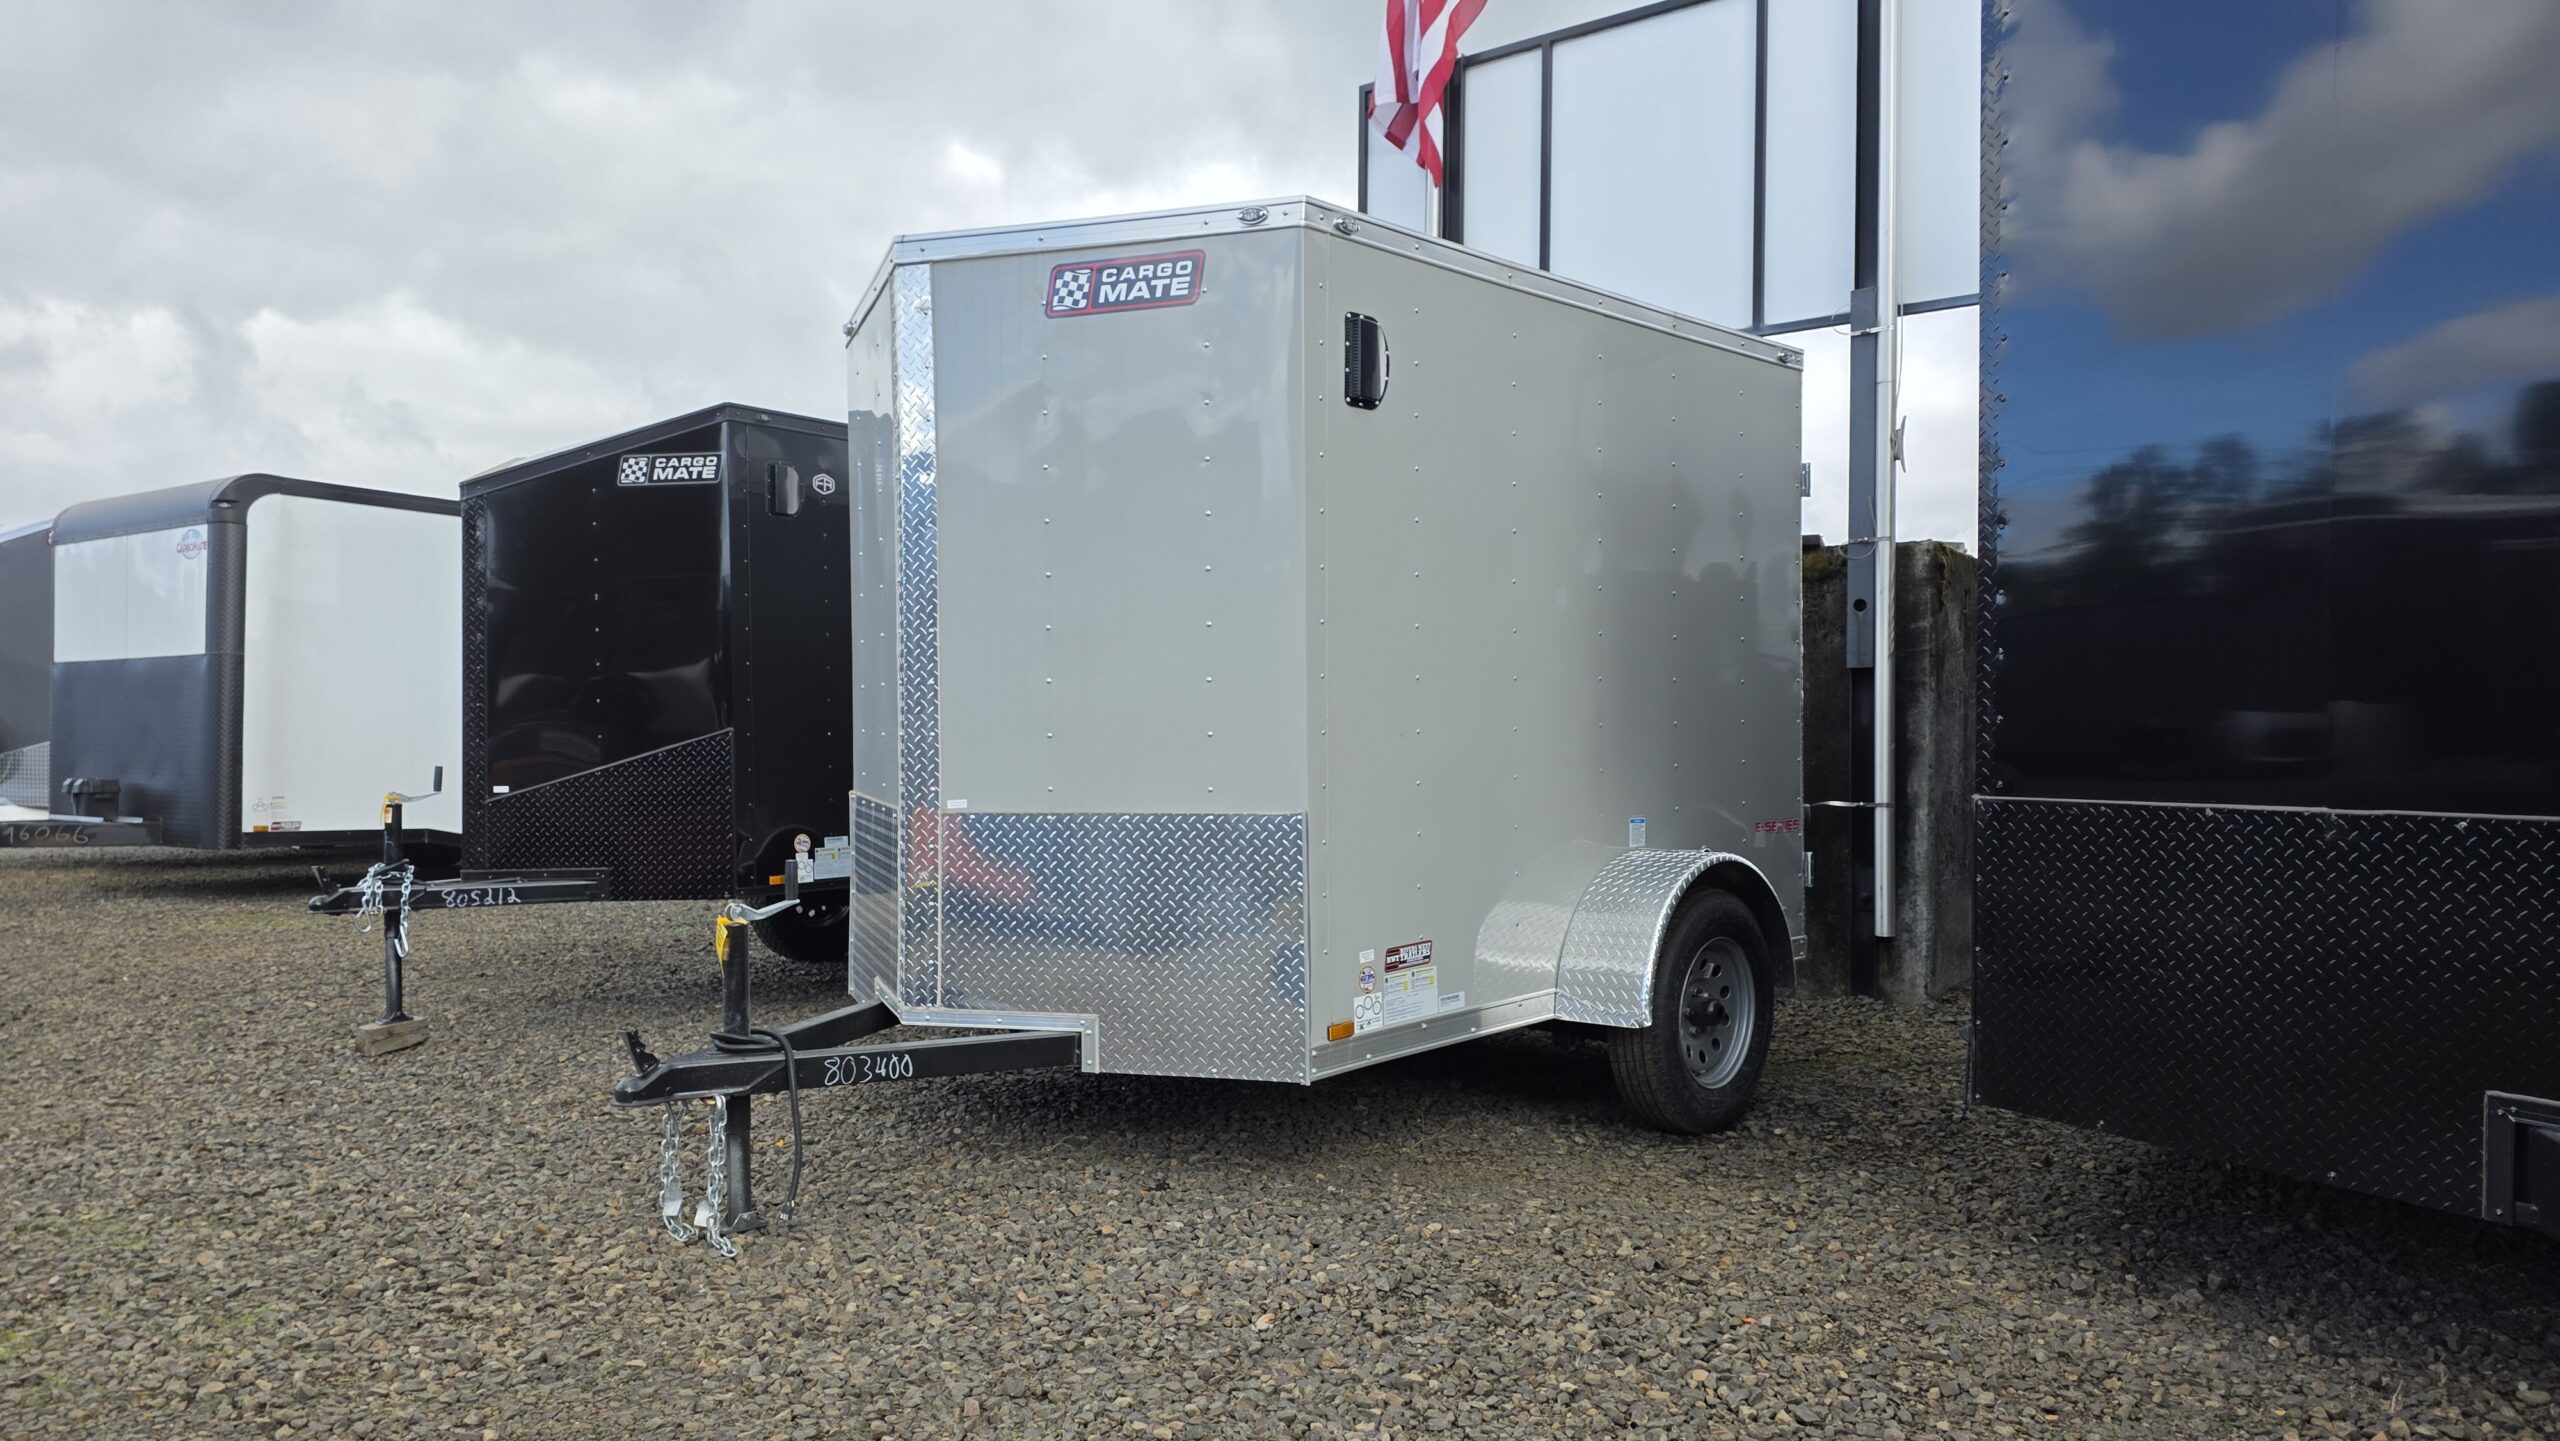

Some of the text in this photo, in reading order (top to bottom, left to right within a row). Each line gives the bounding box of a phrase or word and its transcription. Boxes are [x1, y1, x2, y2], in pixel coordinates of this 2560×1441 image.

[1102, 261, 1192, 282] CARGO
[1098, 276, 1191, 303] MATE
[655, 456, 718, 467] CARGO
[653, 466, 717, 480] MATE
[441, 887, 521, 907] 805212
[824, 1054, 913, 1085] 803400
